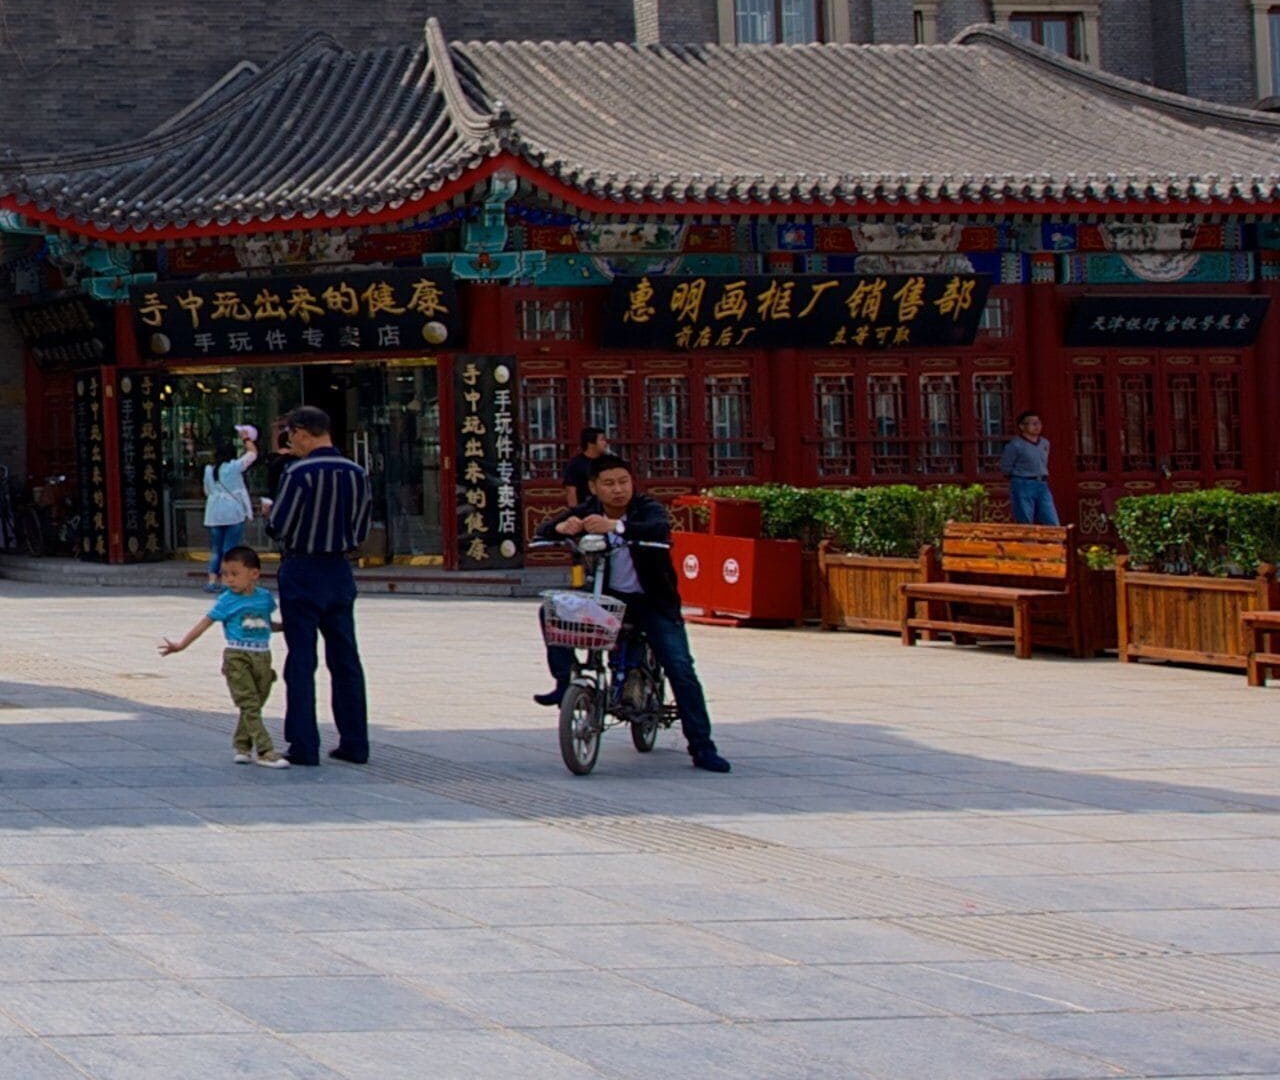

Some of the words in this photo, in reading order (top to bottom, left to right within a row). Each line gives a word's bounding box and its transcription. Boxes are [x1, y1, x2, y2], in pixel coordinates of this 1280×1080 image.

[139, 278, 449, 328] 手中玩出来的健康
[622, 273, 977, 323] 惠明画框厂销售部
[192, 323, 402, 354] 手玩件专卖店
[674, 323, 758, 349] 前店后厂
[828, 323, 912, 347] 立等可取
[460, 363, 489, 561] 手中玩出来的健康
[493, 389, 516, 534] 手玩件专卖店
